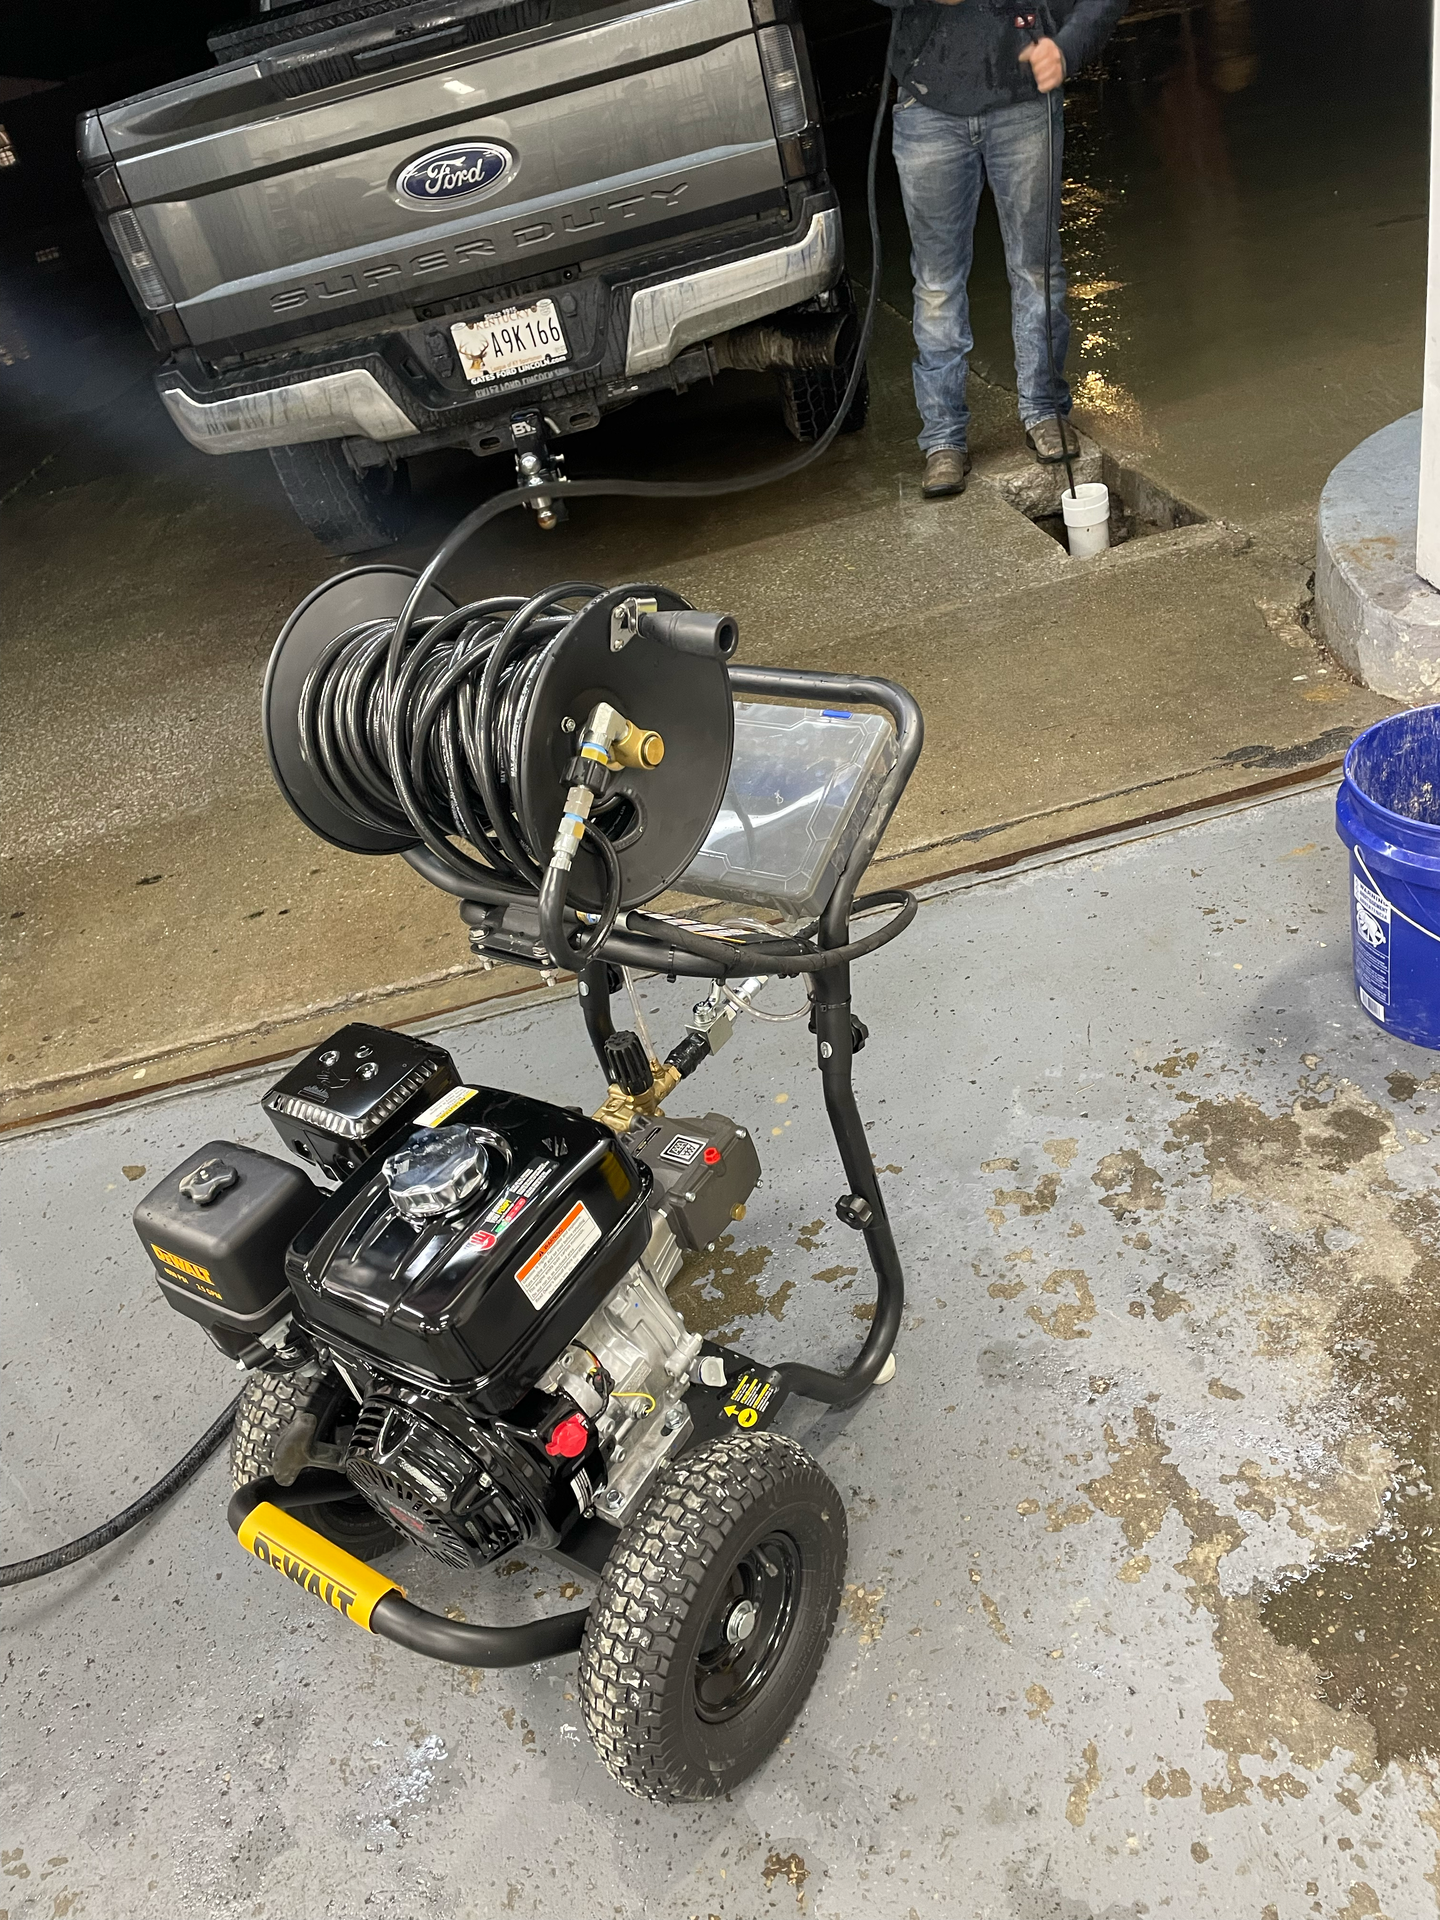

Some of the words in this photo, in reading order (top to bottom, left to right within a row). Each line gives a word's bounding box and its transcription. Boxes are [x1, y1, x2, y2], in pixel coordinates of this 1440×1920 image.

[425, 156, 485, 194] Ford
[270, 237, 496, 313] SUPER
[513, 182, 690, 248] DUTY
[476, 309, 531, 330] KENTUCKY
[471, 371, 496, 385] GATES
[496, 368, 517, 379] FORD
